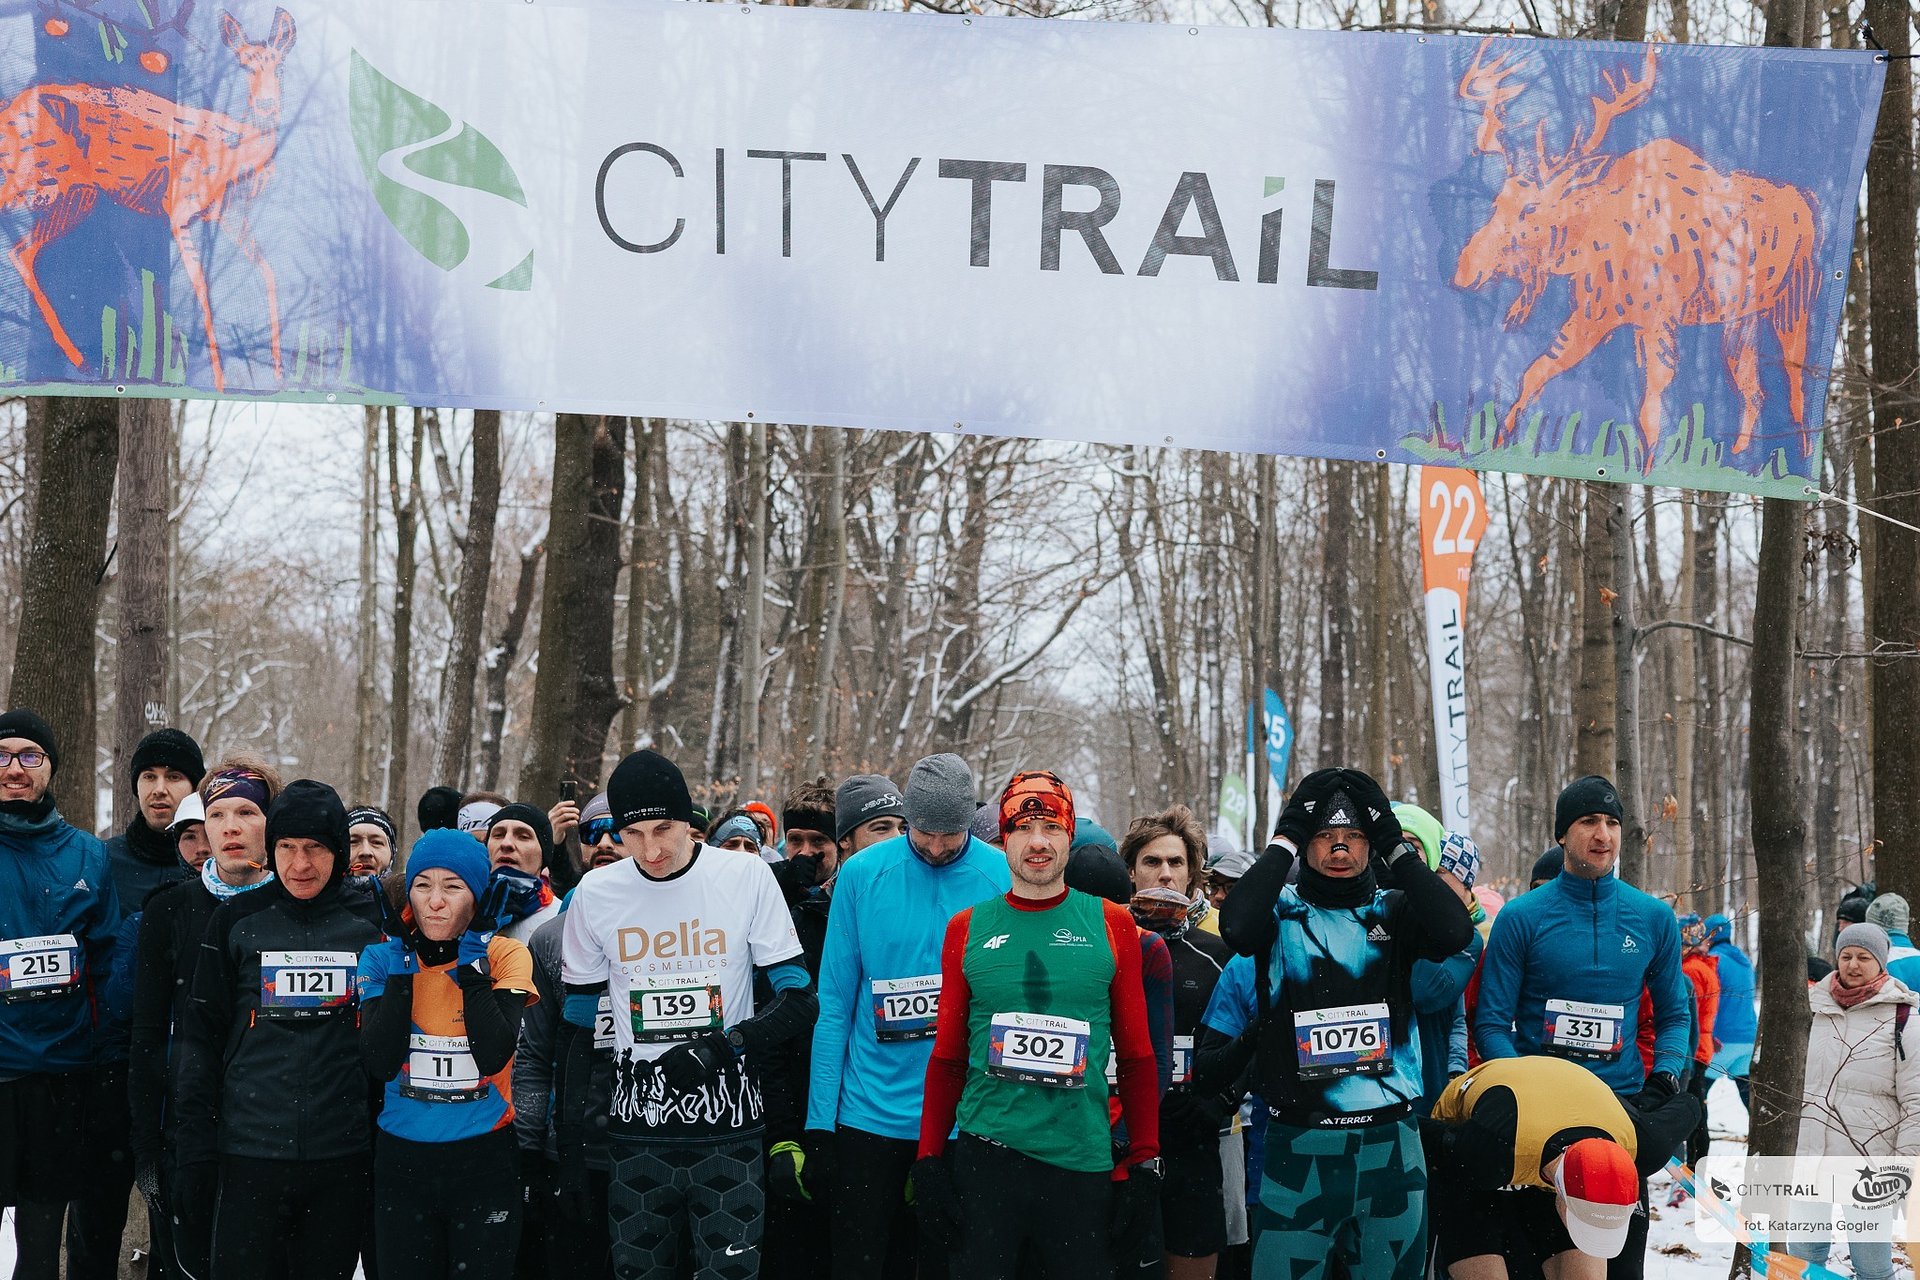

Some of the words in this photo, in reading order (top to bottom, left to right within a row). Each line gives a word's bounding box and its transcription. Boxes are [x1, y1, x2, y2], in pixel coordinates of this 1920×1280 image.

[1429, 480, 1476, 556] 22
[1224, 786, 1247, 816] 28
[1329, 816, 1351, 825] adidas
[617, 918, 728, 963] Delia
[982, 934, 1011, 950] 4F
[20, 954, 60, 976] 215
[621, 958, 729, 975] COSMETICS
[285, 972, 333, 993] 1121
[652, 994, 696, 1016] 139
[886, 994, 940, 1017] 1203
[660, 1019, 692, 1028] TOMASZ
[1566, 1018, 1602, 1039] 331
[1011, 1033, 1065, 1059] 302
[1312, 1025, 1376, 1051] 1076
[432, 1057, 453, 1077] 11
[1333, 1115, 1374, 1125] TERREX
